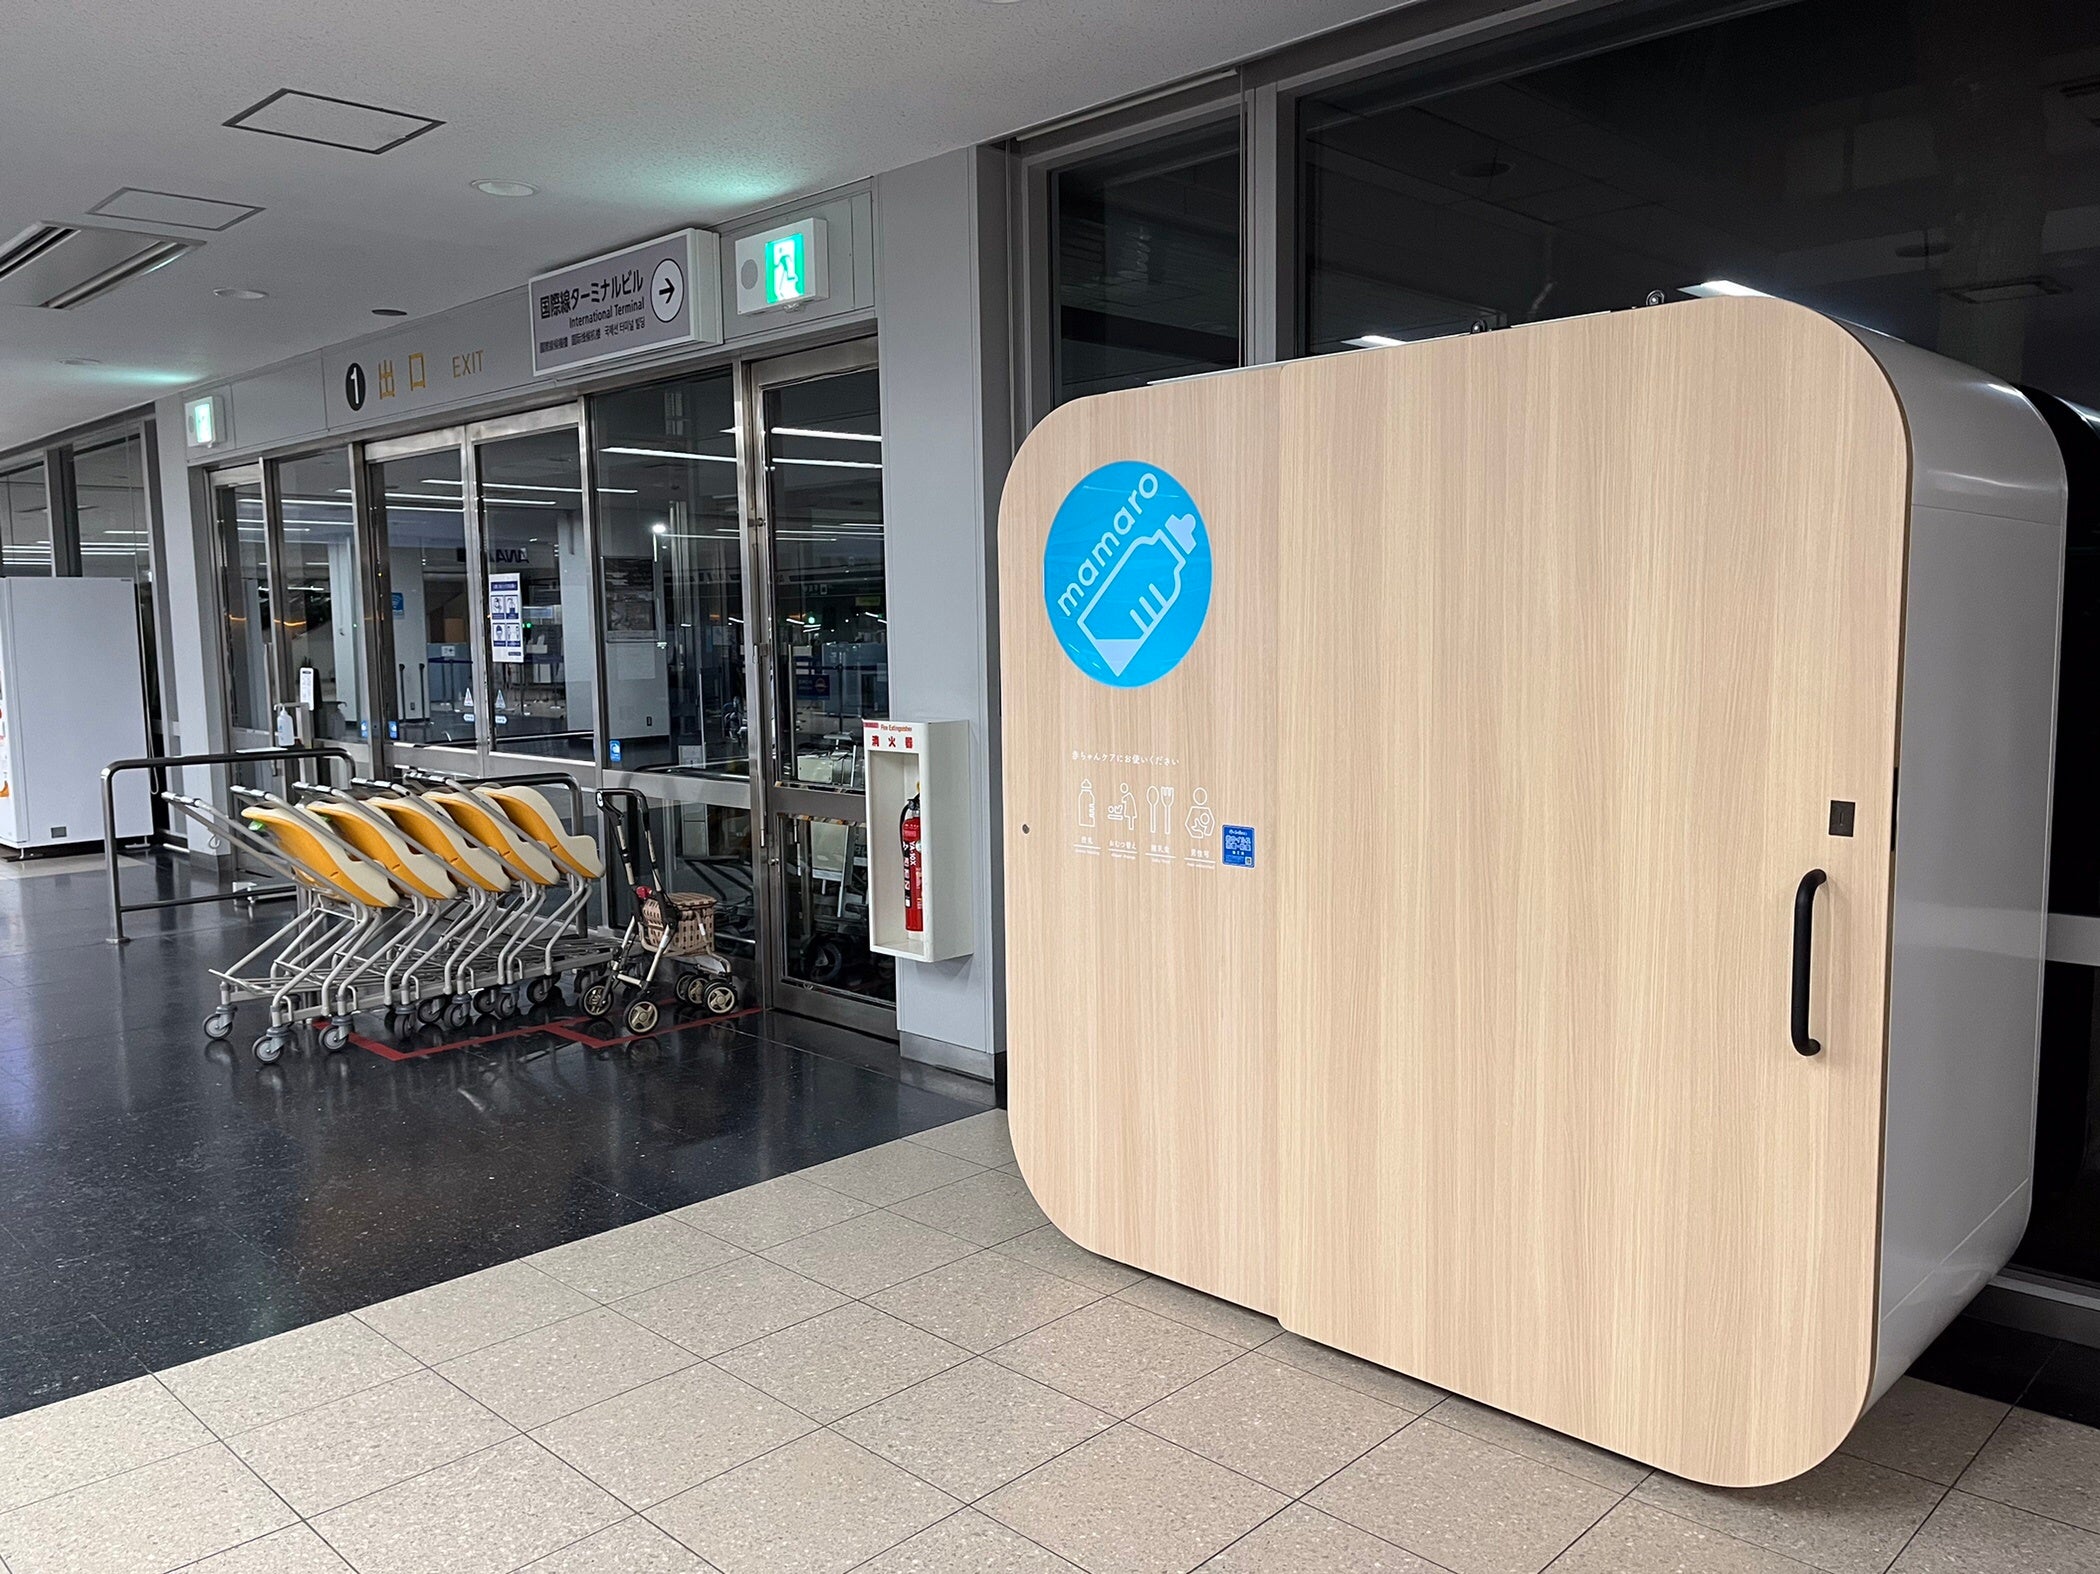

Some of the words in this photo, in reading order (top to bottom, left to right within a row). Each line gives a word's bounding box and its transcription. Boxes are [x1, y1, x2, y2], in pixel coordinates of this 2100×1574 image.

[540, 269, 644, 320] 国際線ターミナルビル
[569, 305, 613, 329] International
[614, 297, 645, 315] Terminal
[378, 352, 426, 400] 出口
[452, 350, 484, 378] EXIT
[1057, 472, 1159, 618] mamaro
